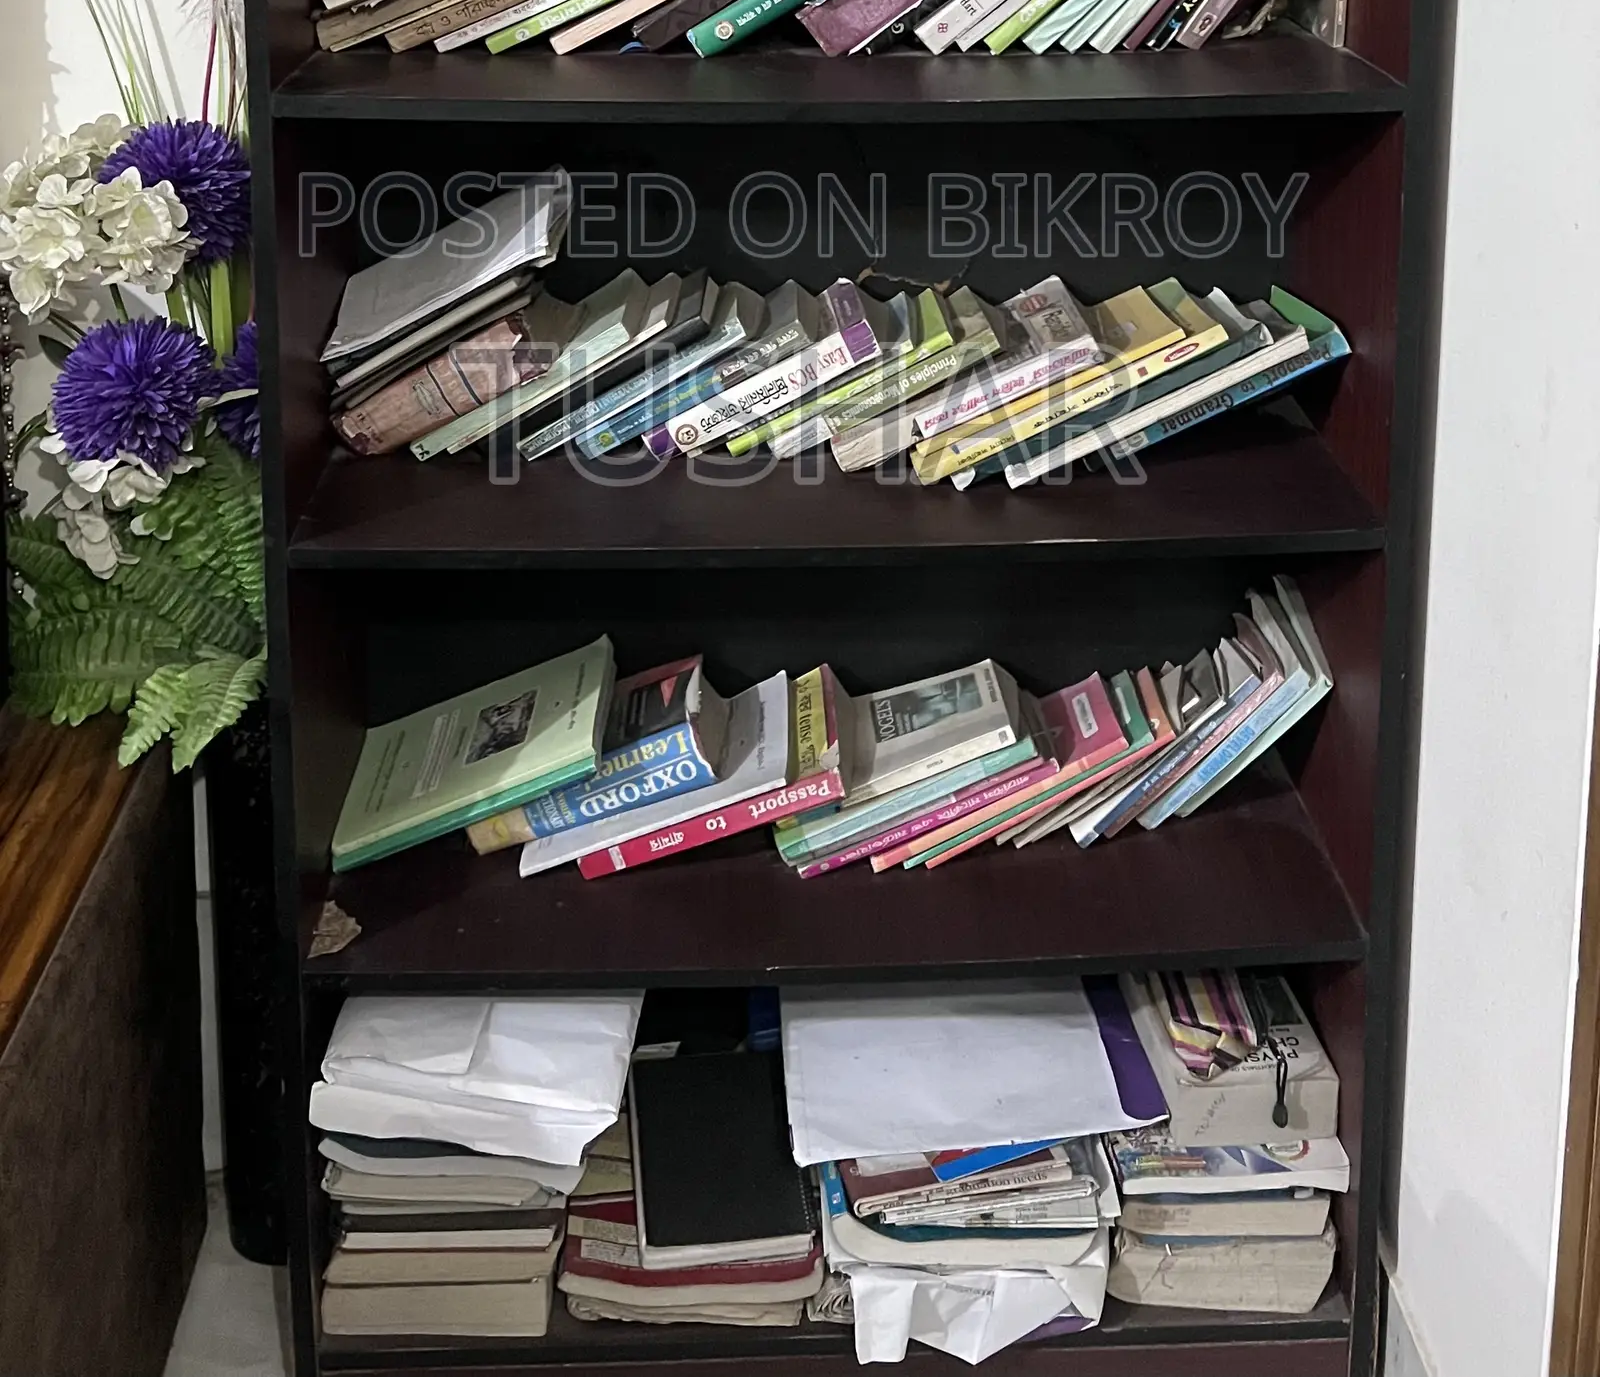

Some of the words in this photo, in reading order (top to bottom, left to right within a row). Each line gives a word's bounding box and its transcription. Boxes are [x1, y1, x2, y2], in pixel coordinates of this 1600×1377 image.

[438, 13, 452, 27] ও
[814, 344, 849, 374] Easy
[907, 350, 958, 387] Principles
[1261, 341, 1332, 387] Passport
[786, 362, 819, 391] BCS
[895, 377, 911, 393] of
[1238, 379, 1256, 397] to
[697, 401, 741, 434] ডাইজেস্ট
[840, 383, 901, 424] Microeconomics
[1157, 389, 1235, 437] Grammar
[799, 714, 812, 744] tense
[580, 759, 697, 817] OXFORD
[747, 779, 831, 820] Passport
[703, 814, 727, 834] to
[647, 829, 685, 852] গ্রামার
[1013, 1171, 1048, 1185] needs
